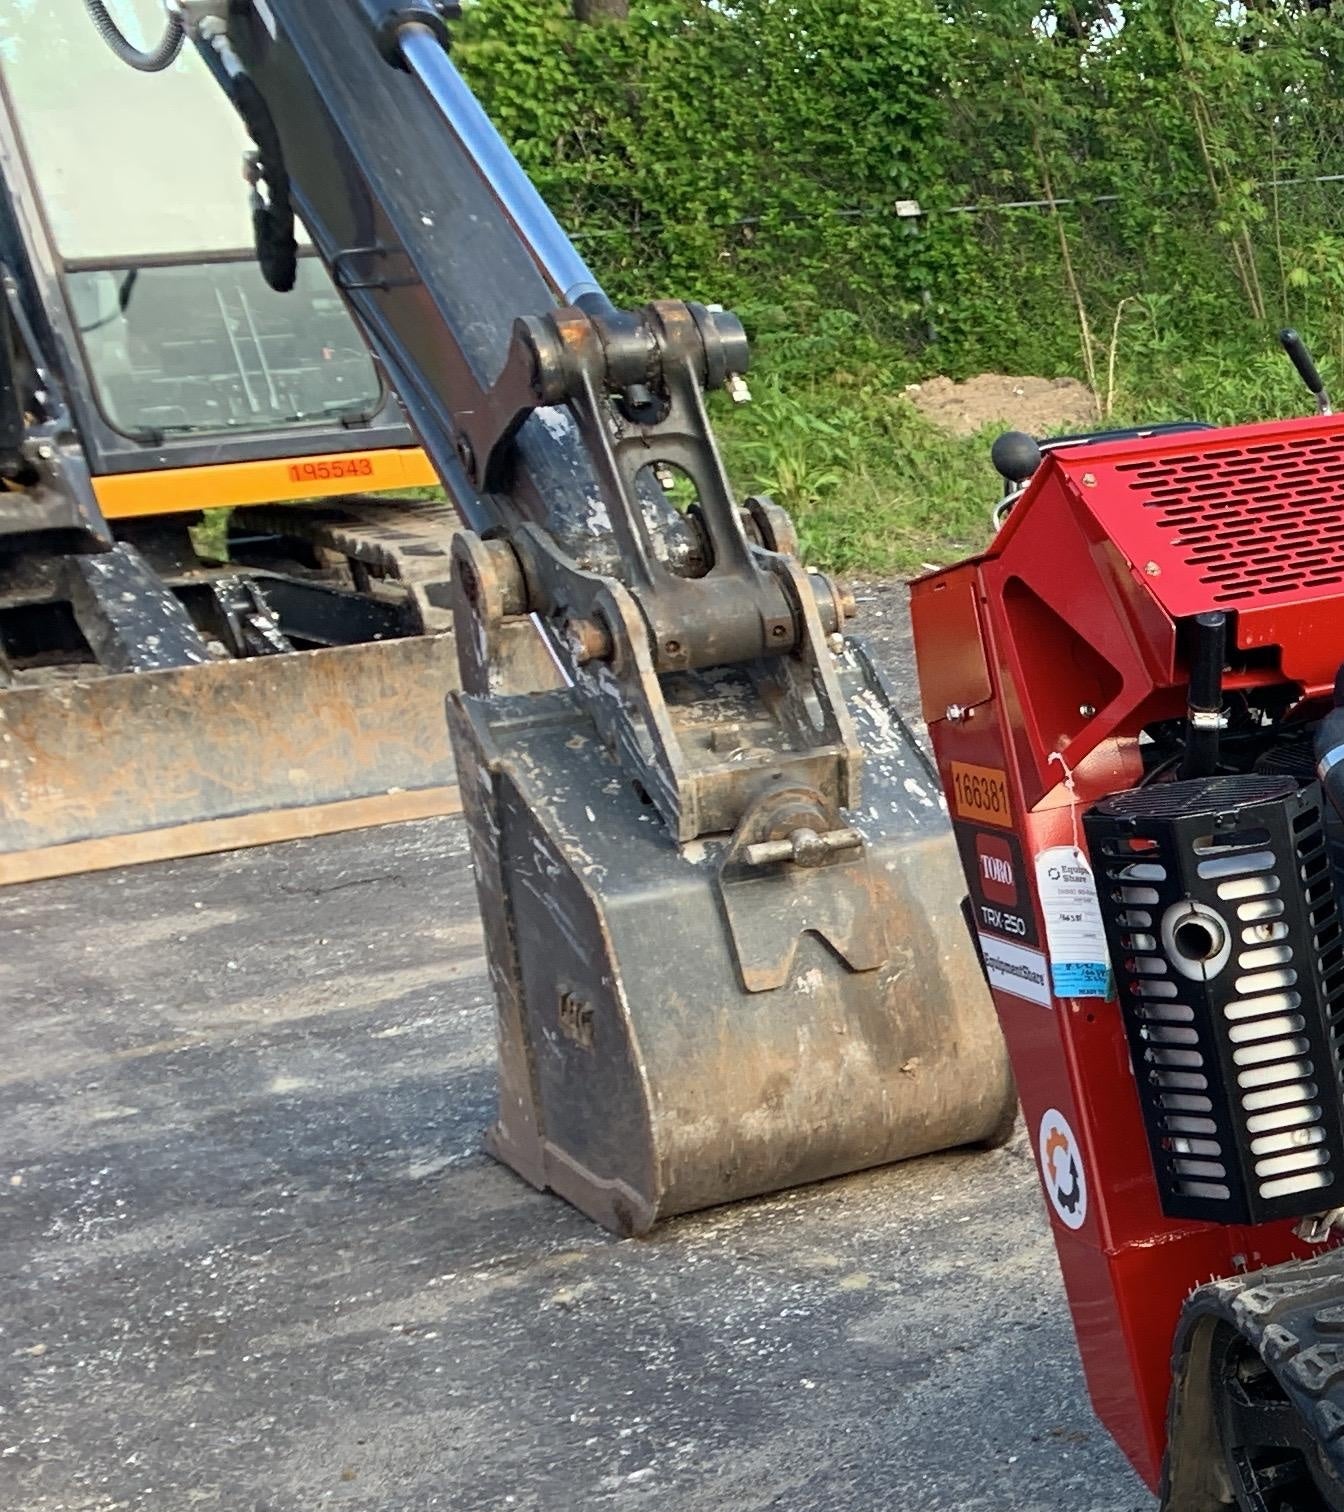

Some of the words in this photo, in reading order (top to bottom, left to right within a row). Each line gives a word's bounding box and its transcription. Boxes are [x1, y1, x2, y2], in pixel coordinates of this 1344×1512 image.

[290, 458, 373, 481] 195543
[955, 772, 1008, 815] 166381
[980, 854, 1013, 886] TORO
[983, 952, 1045, 987] EquipmentShare
